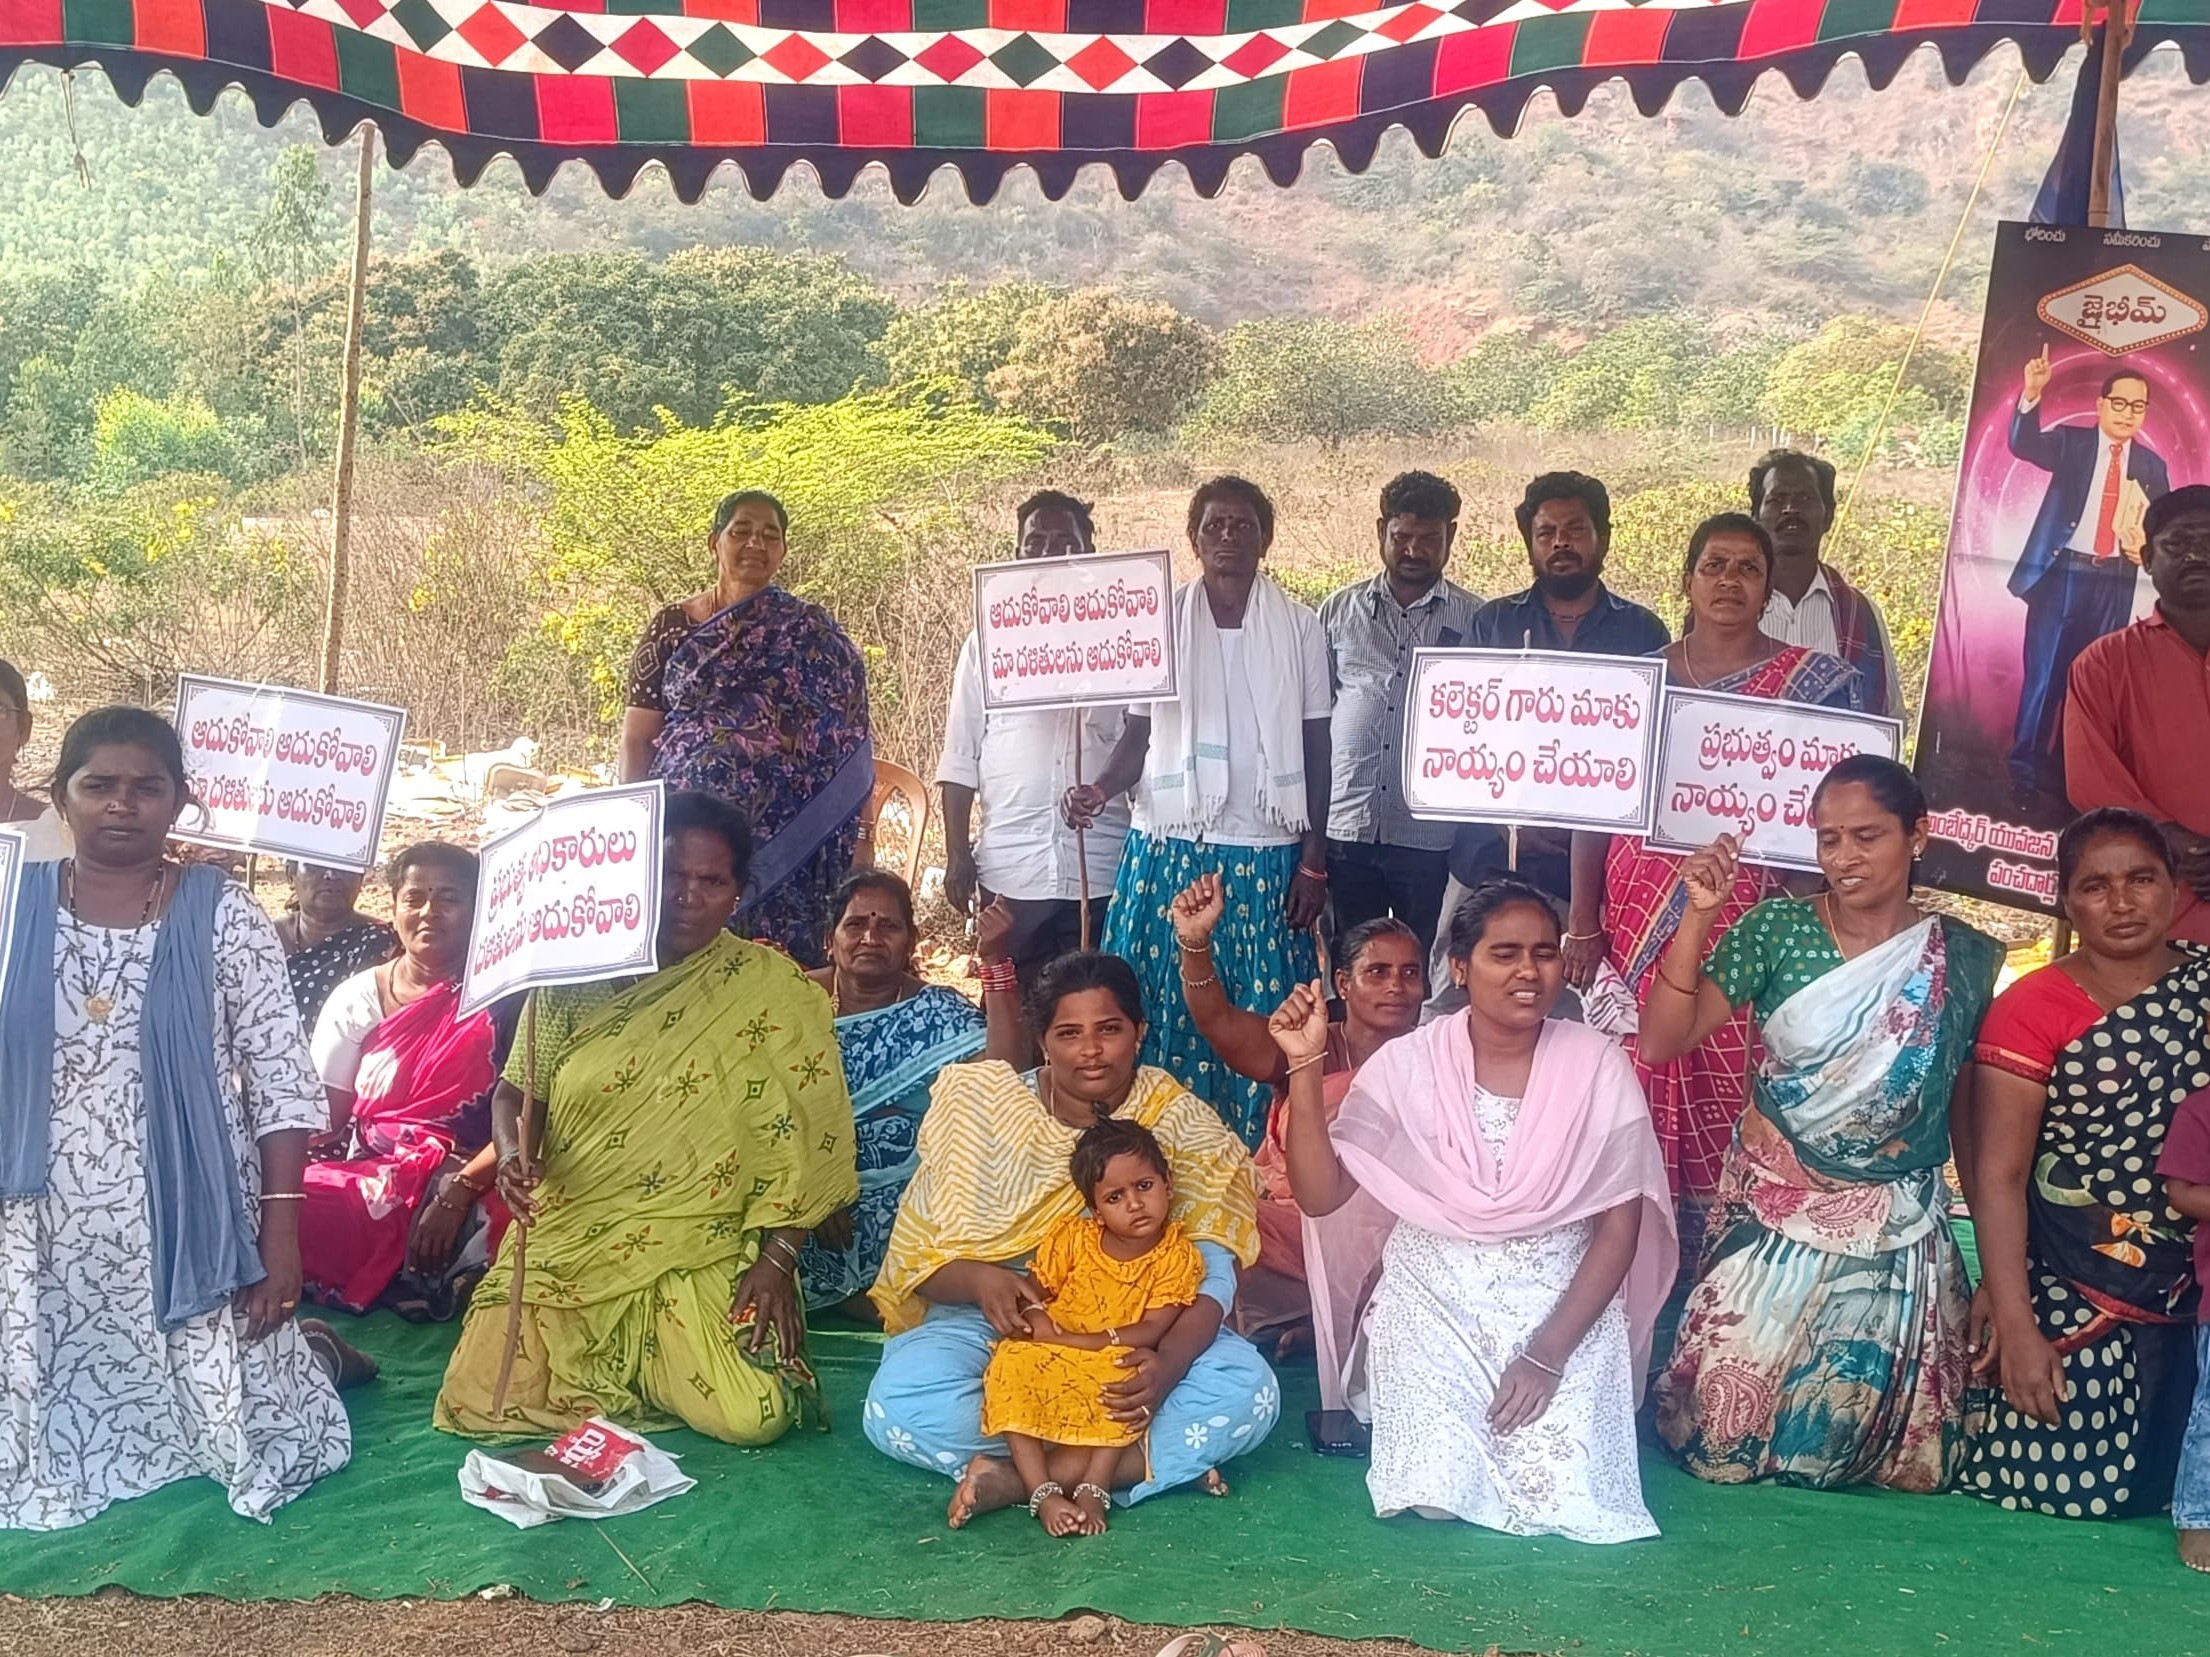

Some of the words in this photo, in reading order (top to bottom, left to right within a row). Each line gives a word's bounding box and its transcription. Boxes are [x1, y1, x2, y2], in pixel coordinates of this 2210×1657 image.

[990, 585, 1070, 629] ఆదుకోవాలి
[1073, 578, 1159, 622] ఆదుకోవాలి
[992, 646, 1014, 680] మా
[1016, 641, 1084, 677] దళితులను
[1086, 629, 1161, 672] ఆదుకోవాలి
[1429, 678, 1502, 734] కలెక్టర్
[1505, 683, 1565, 725] గారు
[1570, 687, 1641, 730] మాకు
[275, 727, 378, 776] ఆదుకోవాలి
[1532, 739, 1637, 791] చేయాలి
[1698, 722, 1796, 779] ప్రభుత్వం
[209, 774, 274, 815] దళితును
[277, 783, 367, 833] ఆదుకోవాలి
[1988, 825, 2054, 857] యువజన
[528, 886, 641, 943] ఆదుకోవాలి
